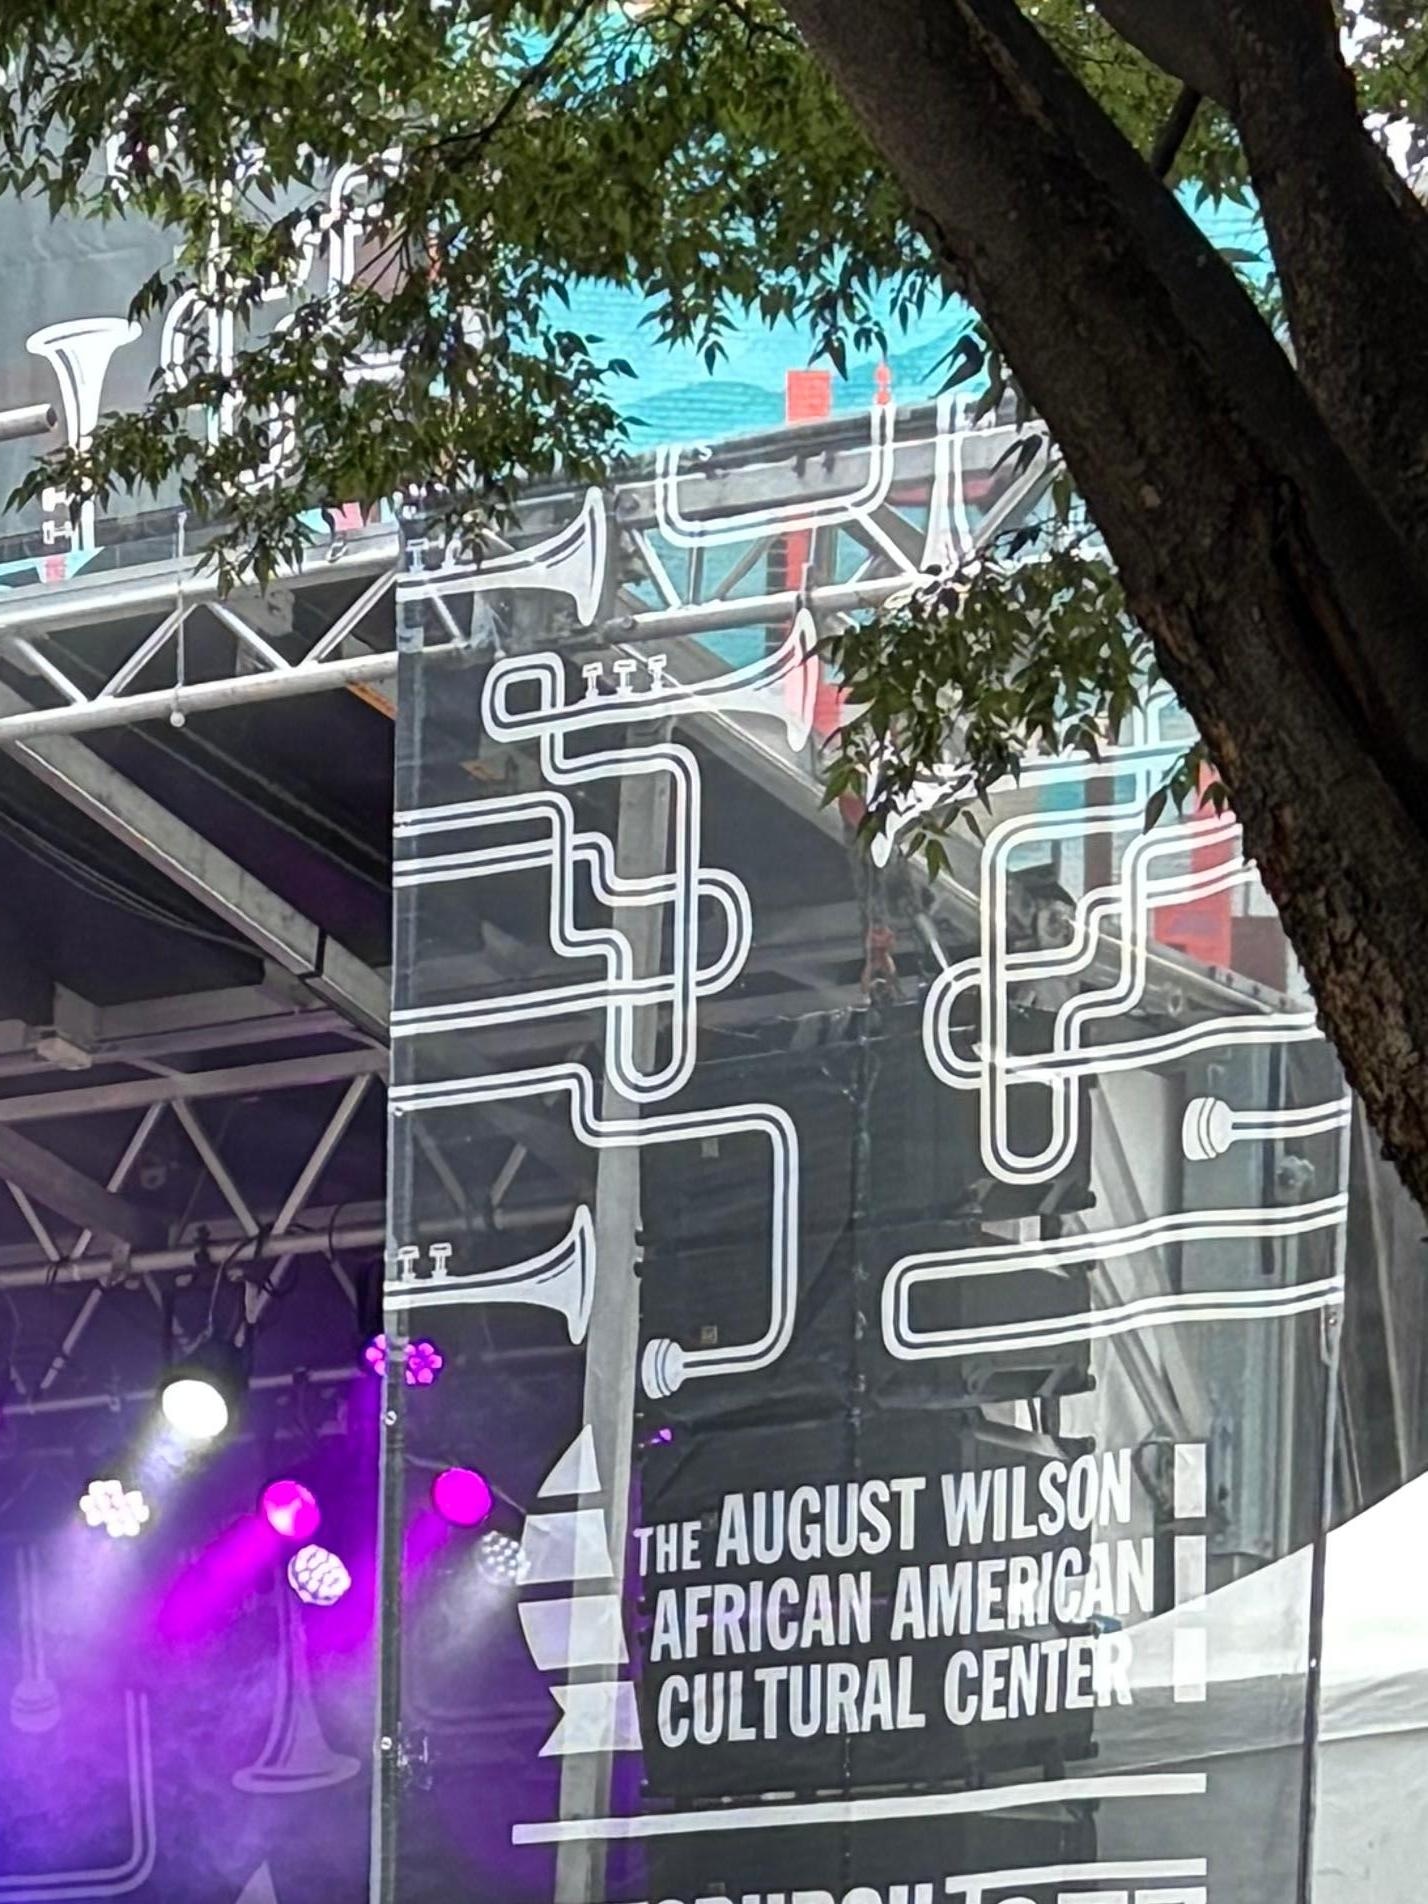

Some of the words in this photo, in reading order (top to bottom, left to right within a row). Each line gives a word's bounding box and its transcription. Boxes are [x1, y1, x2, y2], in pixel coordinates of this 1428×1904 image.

[634, 1525, 700, 1577] THE
[715, 1477, 927, 1568] AUGUST
[942, 1447, 1132, 1546] WILSON
[650, 1568, 872, 1663] AFRICAN
[889, 1536, 1154, 1640] AMERICAN
[657, 1657, 926, 1748] CULTURAL
[946, 1632, 1132, 1727] CENTER
